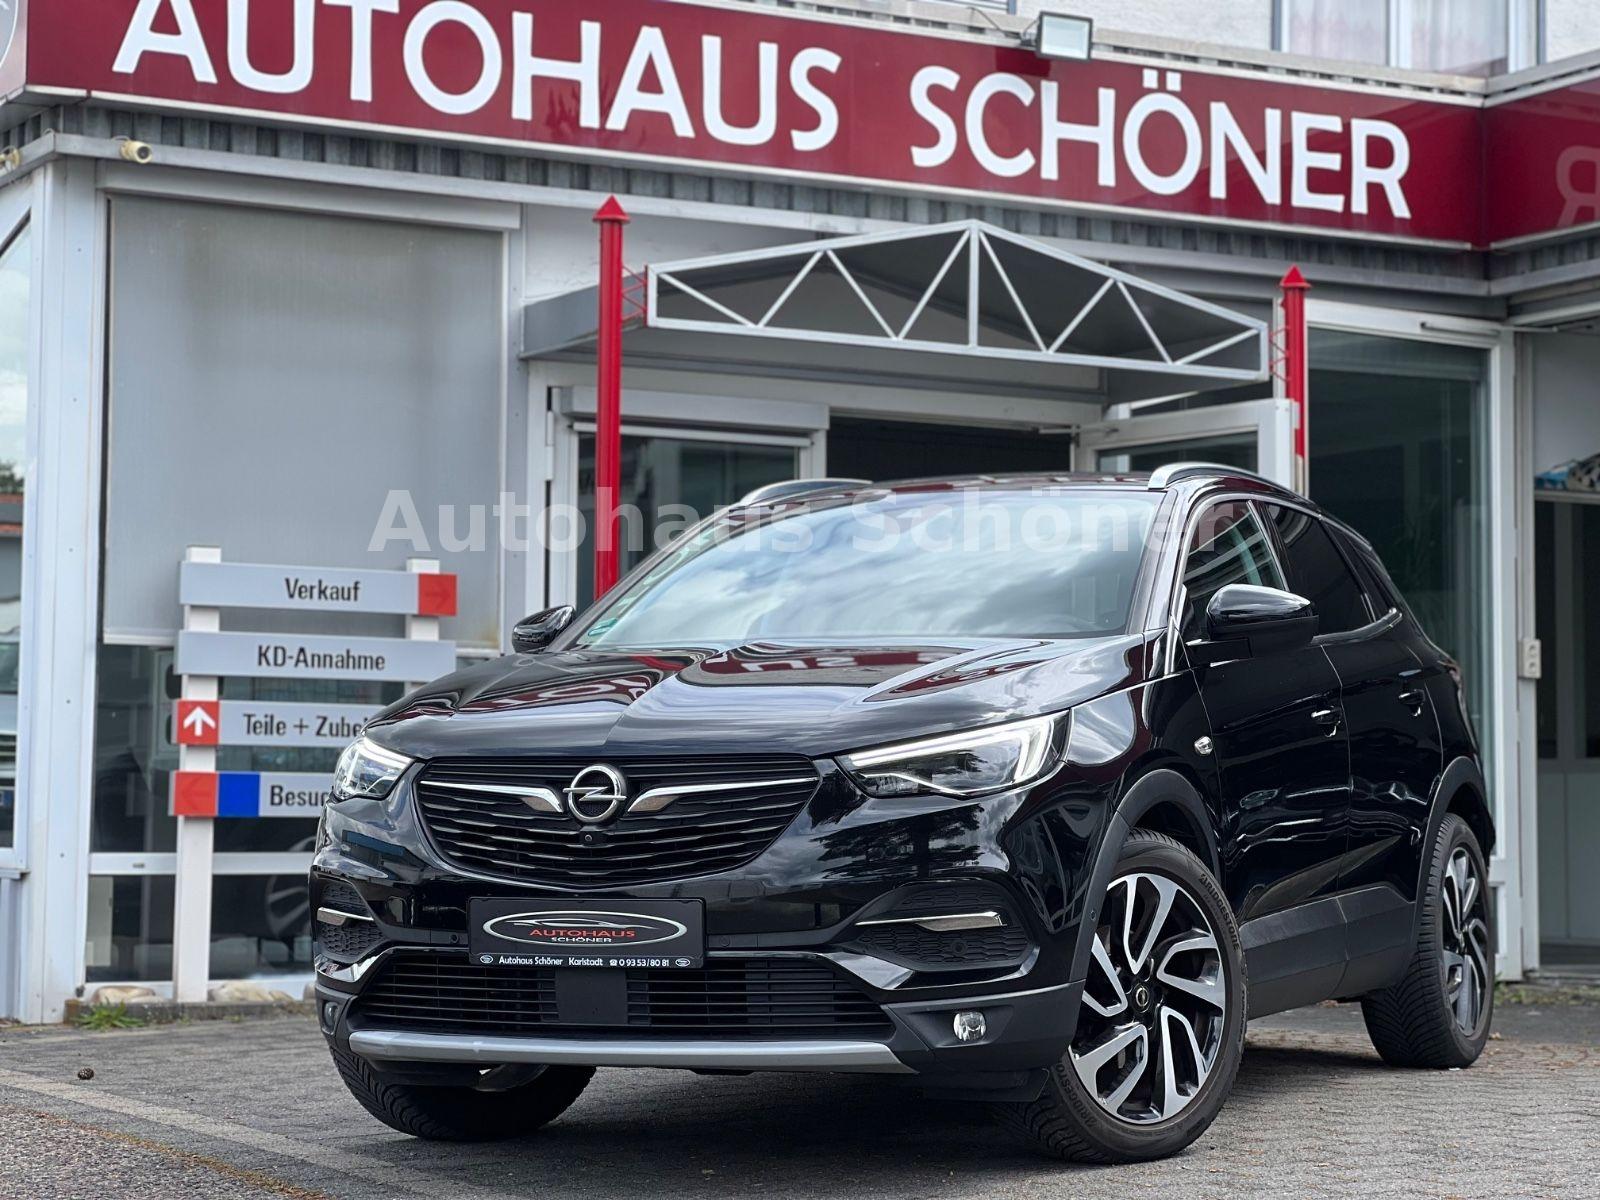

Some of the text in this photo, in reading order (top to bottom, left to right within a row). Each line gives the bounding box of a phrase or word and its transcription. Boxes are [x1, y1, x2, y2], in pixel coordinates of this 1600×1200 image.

[113, 0, 1412, 220] AUTOHAUS SCHÖNER
[285, 578, 360, 602] Verkauf
[257, 645, 386, 671] KD-Annahme
[244, 713, 368, 737] Teile + Zube
[529, 929, 635, 938] AUTOHAUS
[499, 955, 533, 965] Autohaus
[534, 956, 563, 966] Schöner
[568, 957, 603, 967] Karlstadt
